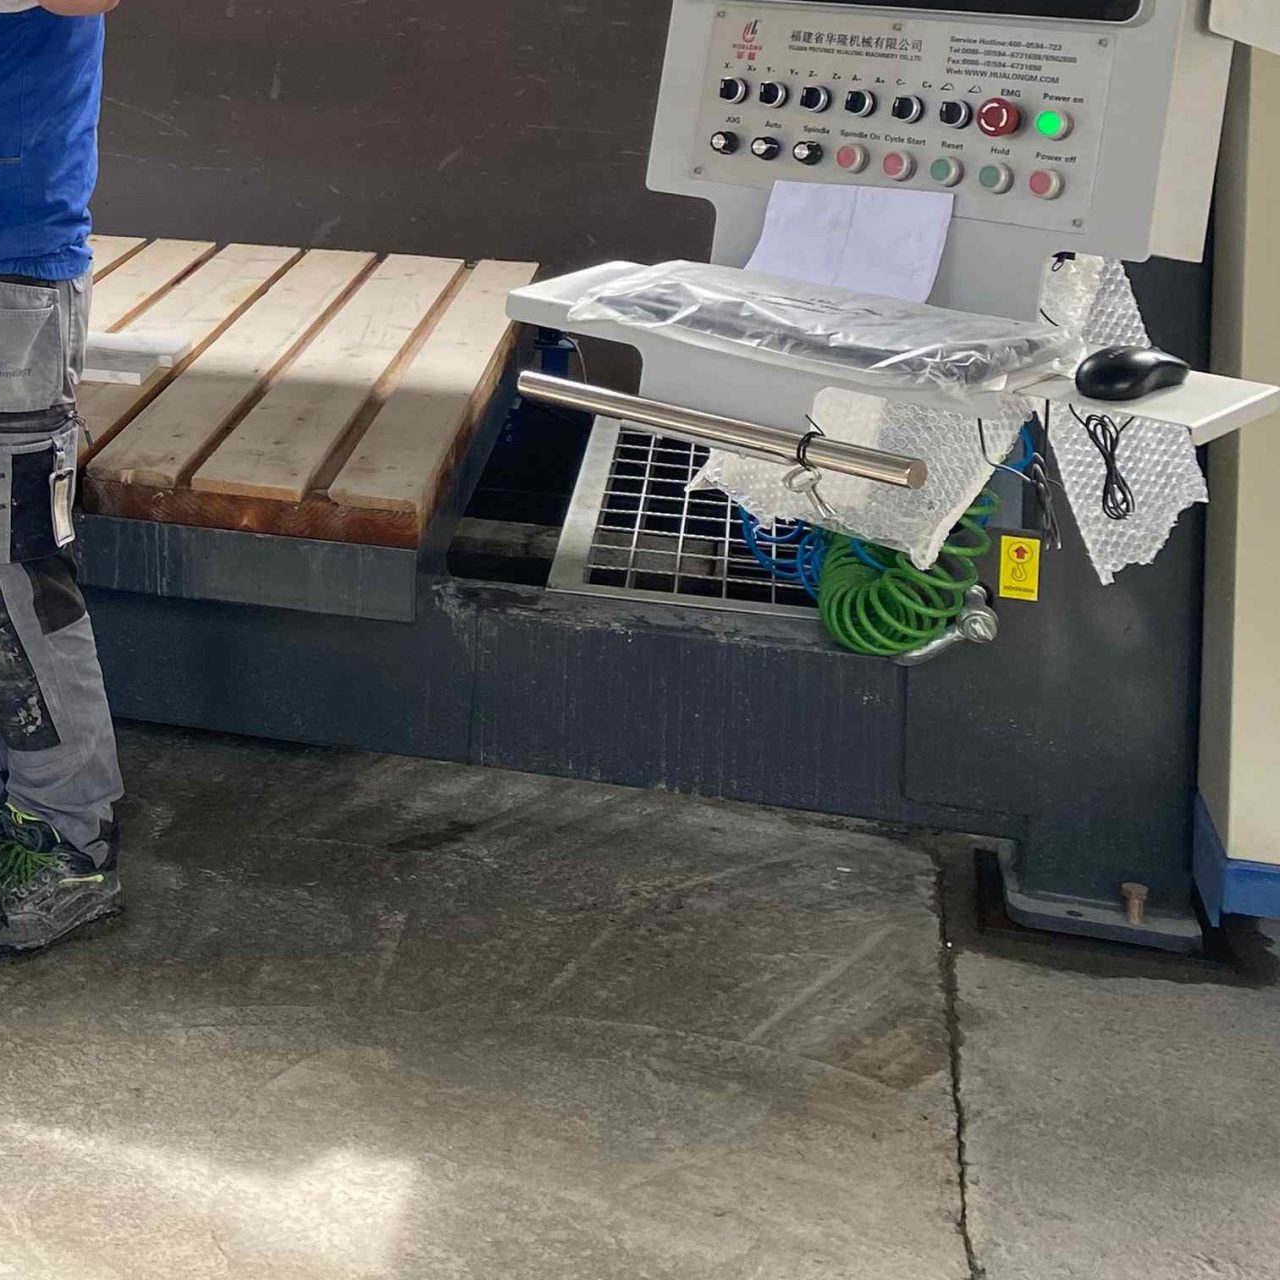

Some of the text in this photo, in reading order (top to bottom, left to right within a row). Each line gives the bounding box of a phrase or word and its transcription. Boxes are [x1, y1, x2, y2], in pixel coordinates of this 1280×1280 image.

[791, 30, 923, 53] 福建省华隆机械有限公司
[1001, 88, 1021, 98] EMG
[1043, 93, 1071, 103] Power
[725, 116, 740, 124] JOG
[764, 120, 782, 129] Auto
[803, 124, 830, 135] Spindle
[840, 128, 881, 140] Spindle On
[884, 134, 927, 146] Cycle Start
[941, 140, 963, 150] Reset
[990, 146, 1010, 156] Hold
[1035, 151, 1077, 164] Power off
